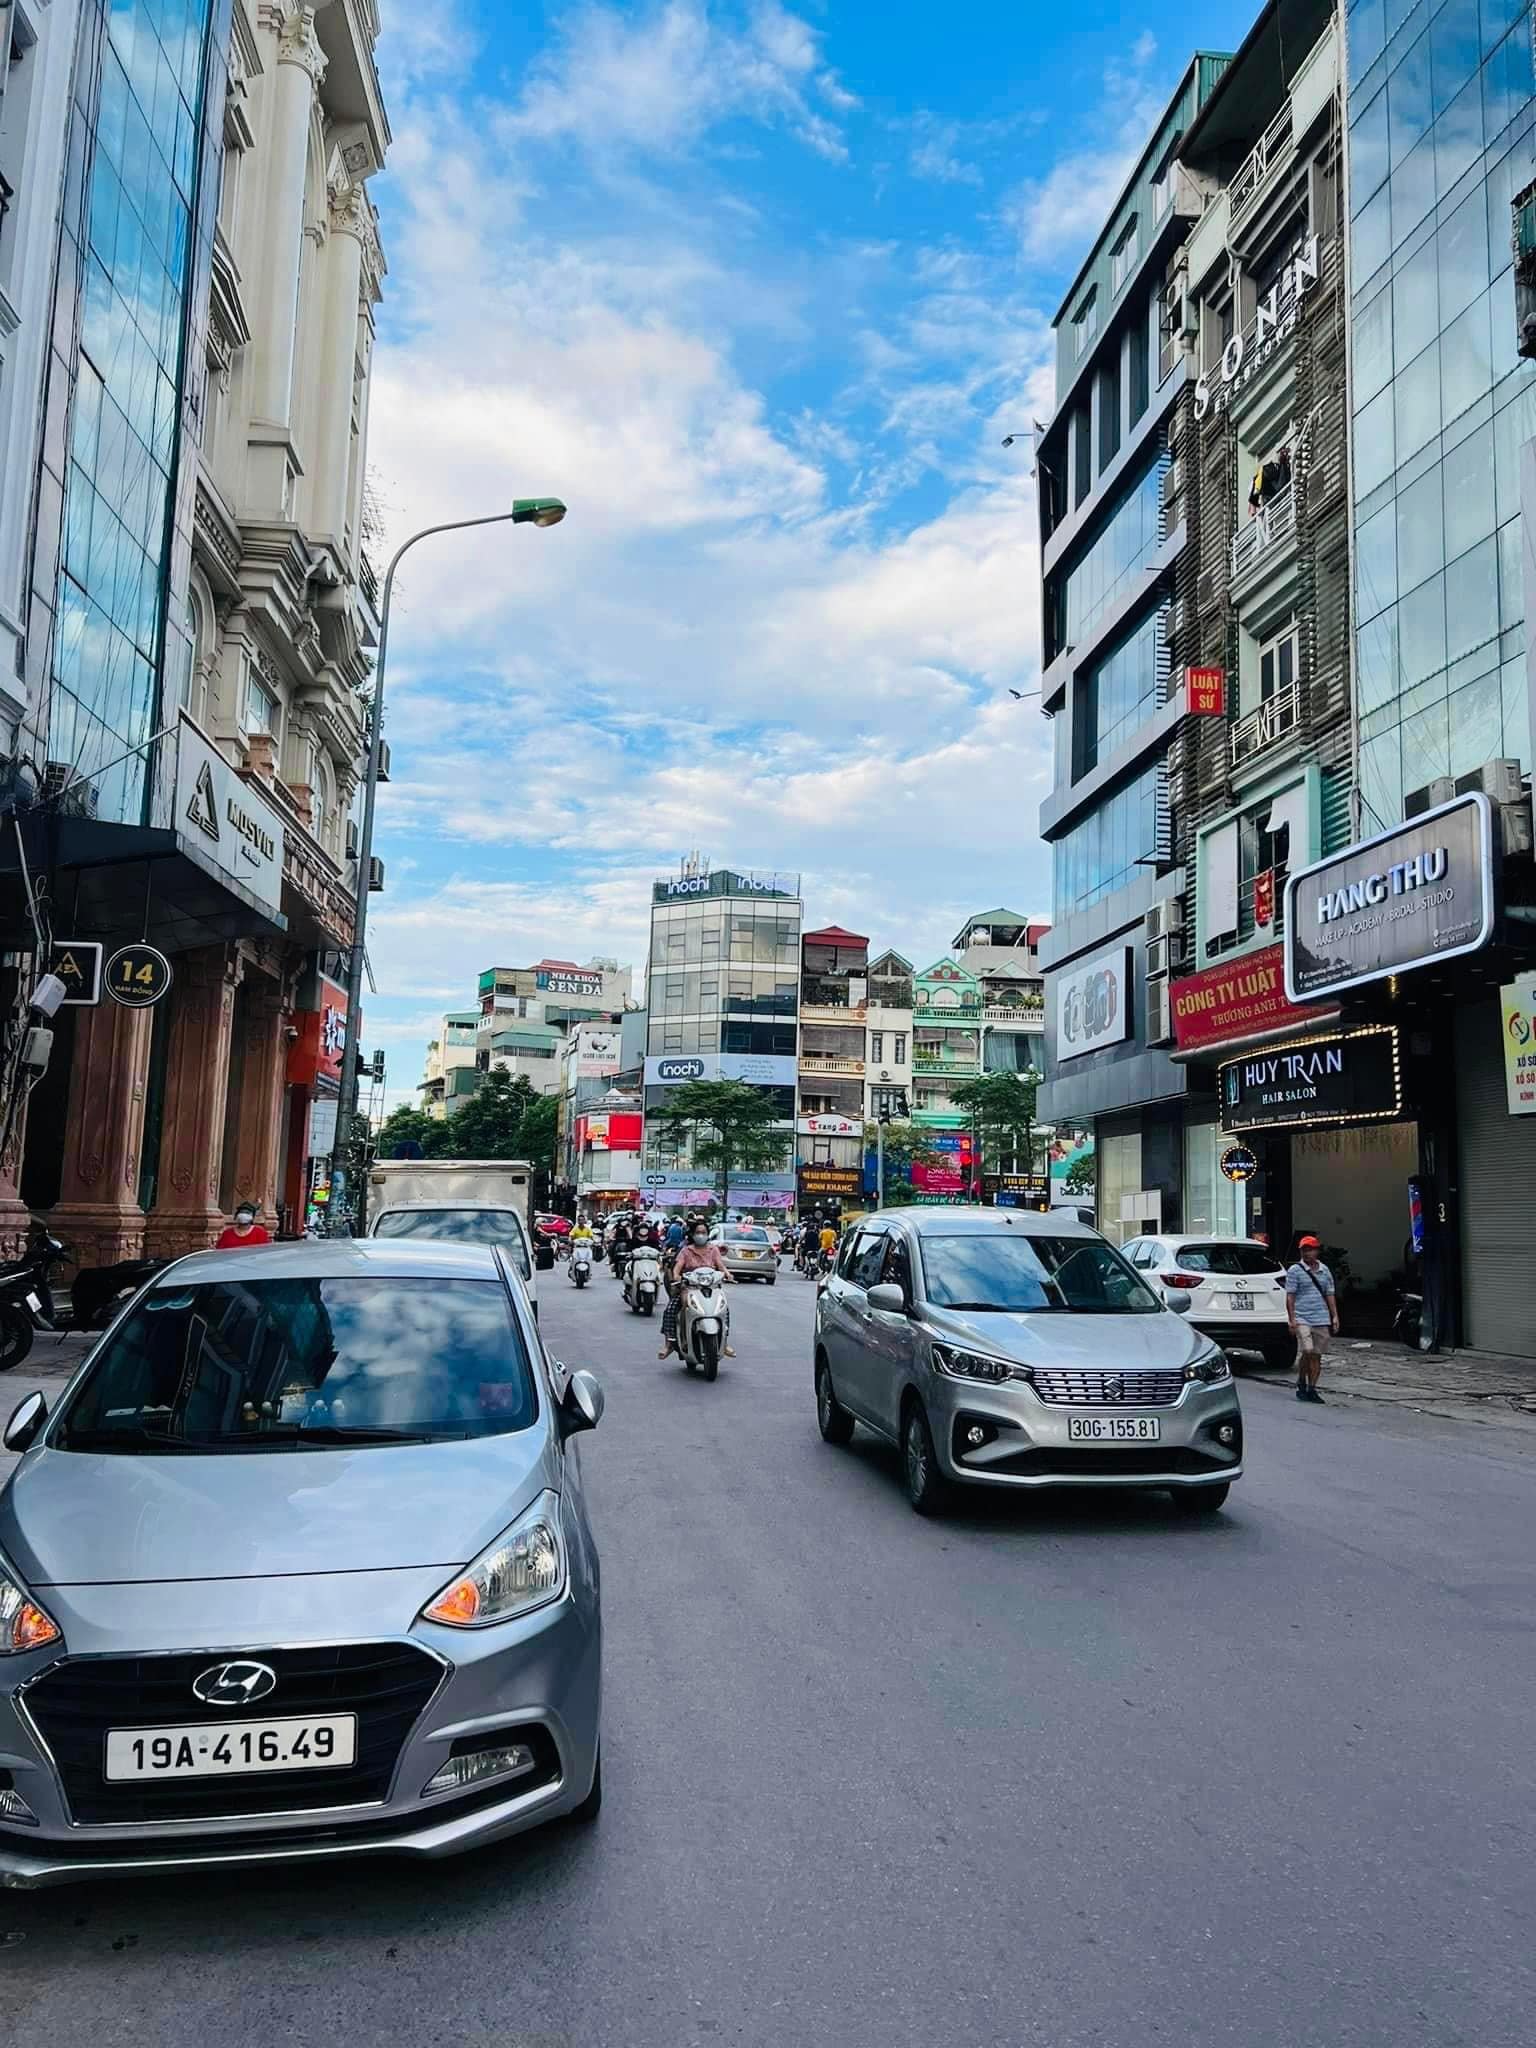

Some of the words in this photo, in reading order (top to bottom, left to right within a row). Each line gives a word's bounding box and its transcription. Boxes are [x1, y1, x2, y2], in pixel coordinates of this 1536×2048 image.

[1192, 672, 1220, 692] LUẬT
[1199, 693, 1216, 709] SƯ
[667, 876, 710, 895] inochi
[1318, 874, 1388, 924] HANG
[1388, 848, 1448, 895] THU
[1422, 887, 1455, 911] STUDIO
[122, 960, 153, 984] 14
[574, 974, 600, 983] KHOA
[547, 980, 577, 993] SEN
[1176, 988, 1216, 1016] CÔNG
[1216, 980, 1236, 1004] TY
[1240, 967, 1277, 997] LUẬT
[1254, 999, 1278, 1015] ANH
[662, 1060, 700, 1076] inochi
[1245, 1059, 1278, 1088] HUY
[1281, 1049, 1342, 1084] TRAN
[1262, 1092, 1285, 1105] HAIR
[1285, 1086, 1317, 1101] SALON
[826, 1184, 853, 1192] KHANG
[1072, 1420, 1156, 1437] 30G-155.81
[132, 1727, 335, 1770] 19A-416.49
